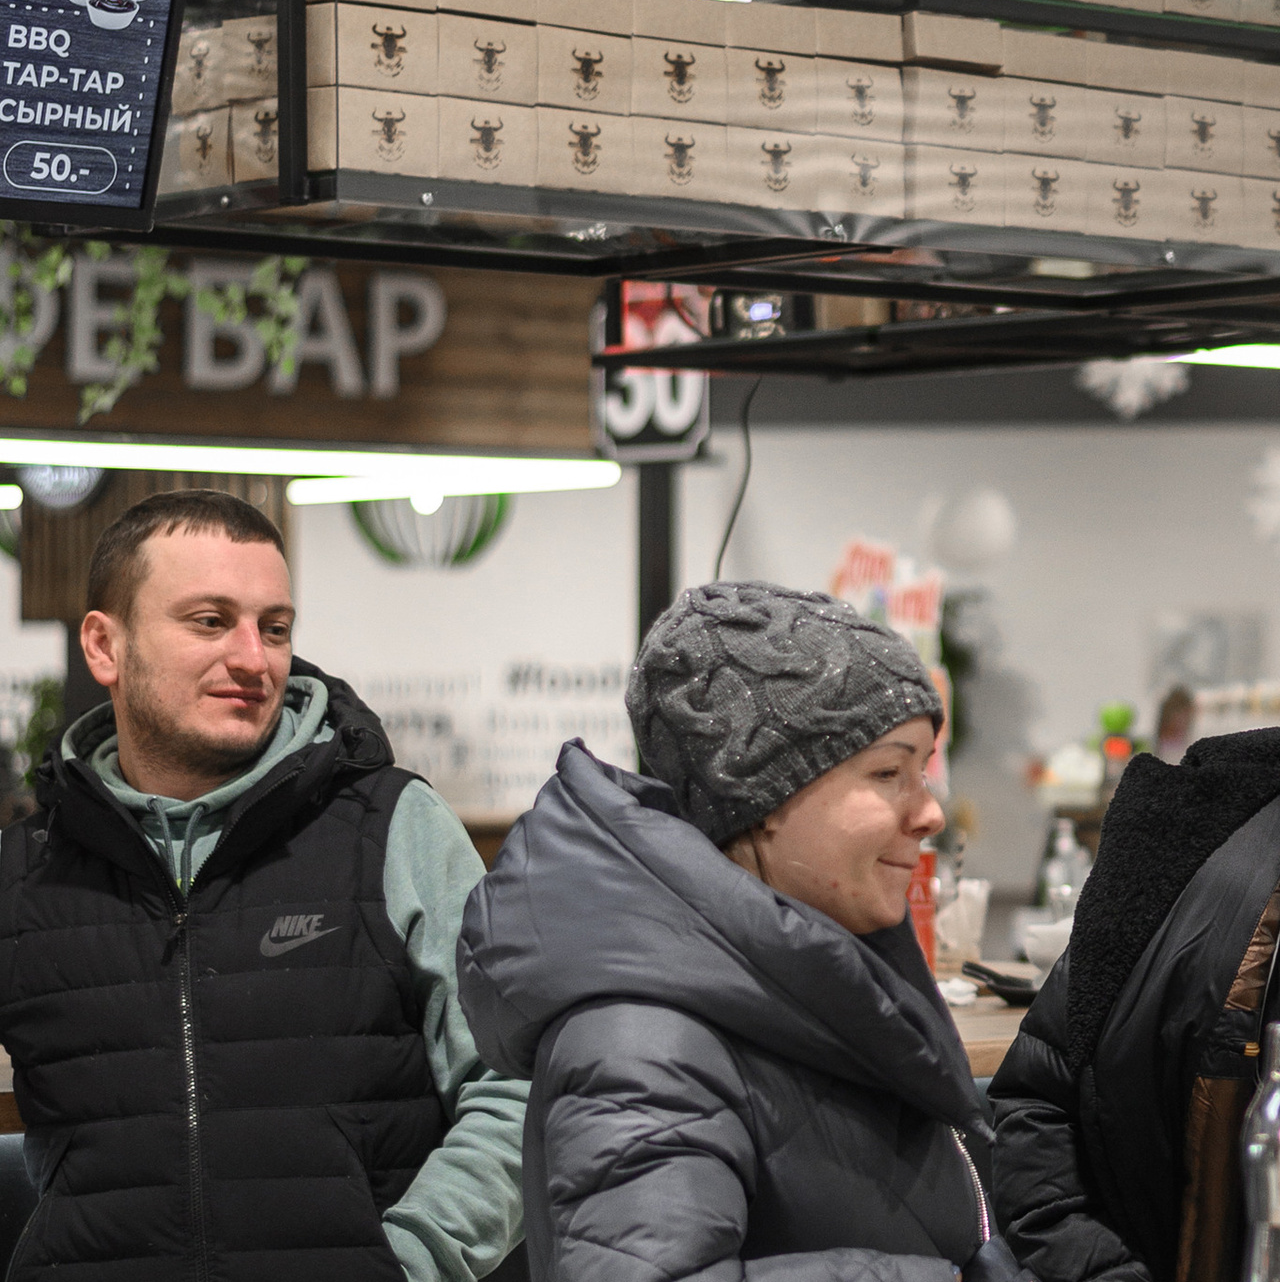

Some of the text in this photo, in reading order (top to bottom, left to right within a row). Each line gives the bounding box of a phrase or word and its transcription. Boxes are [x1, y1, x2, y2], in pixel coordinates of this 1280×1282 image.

[7, 24, 71, 58] BBQ
[3, 61, 124, 94] ТАР-ТАР
[0, 98, 132, 133] СЫРНЫЙ
[30, 151, 90, 183] 50.-
[270, 914, 324, 937] NIKE
